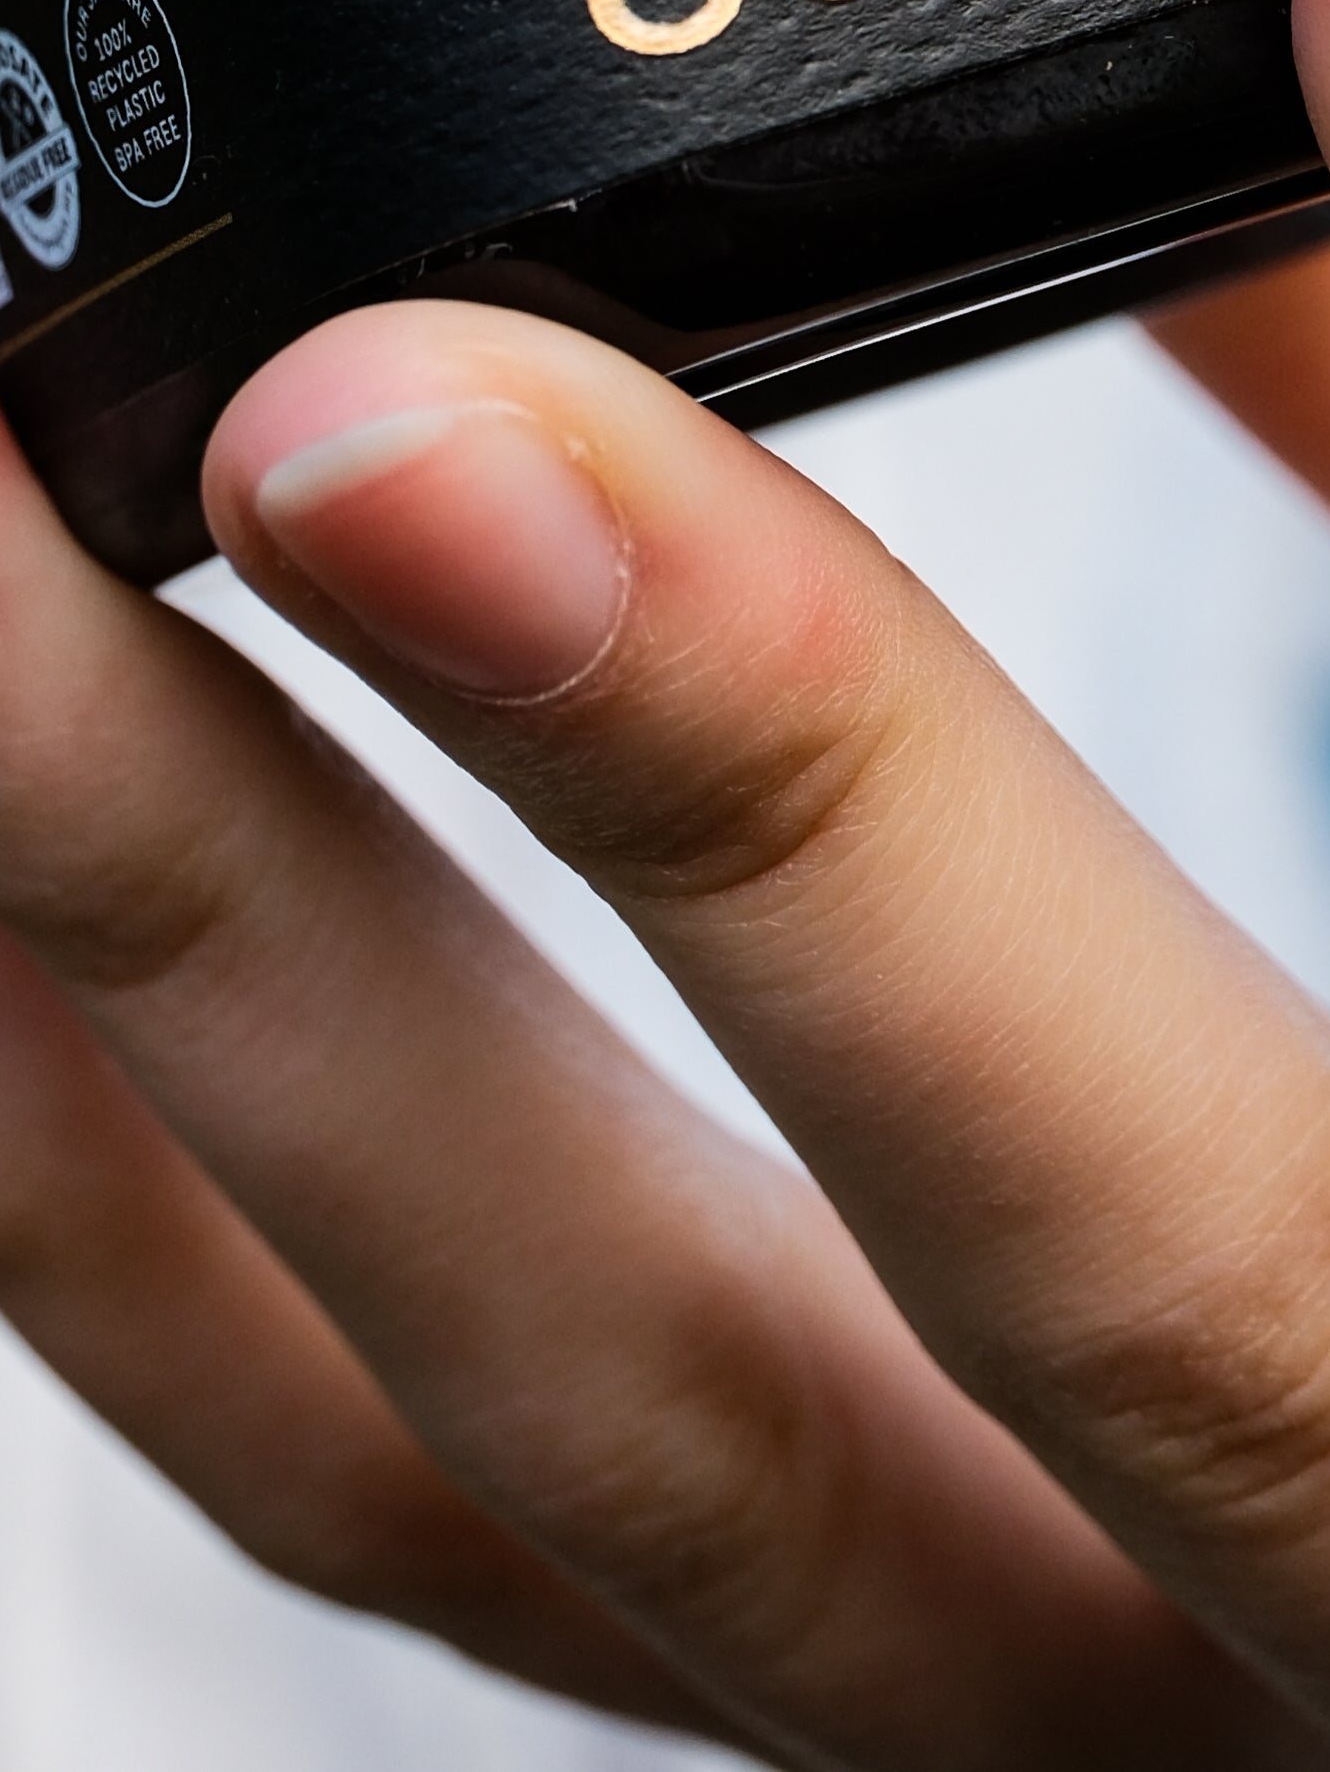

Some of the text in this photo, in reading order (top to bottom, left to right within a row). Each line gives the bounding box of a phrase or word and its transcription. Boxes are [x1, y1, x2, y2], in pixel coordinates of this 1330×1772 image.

[76, 6, 91, 63] OUR
[93, 18, 132, 63] 100%
[87, 43, 161, 104] RECYCLED
[106, 79, 167, 132] PLASTIC
[114, 113, 183, 174] BPA FREE
